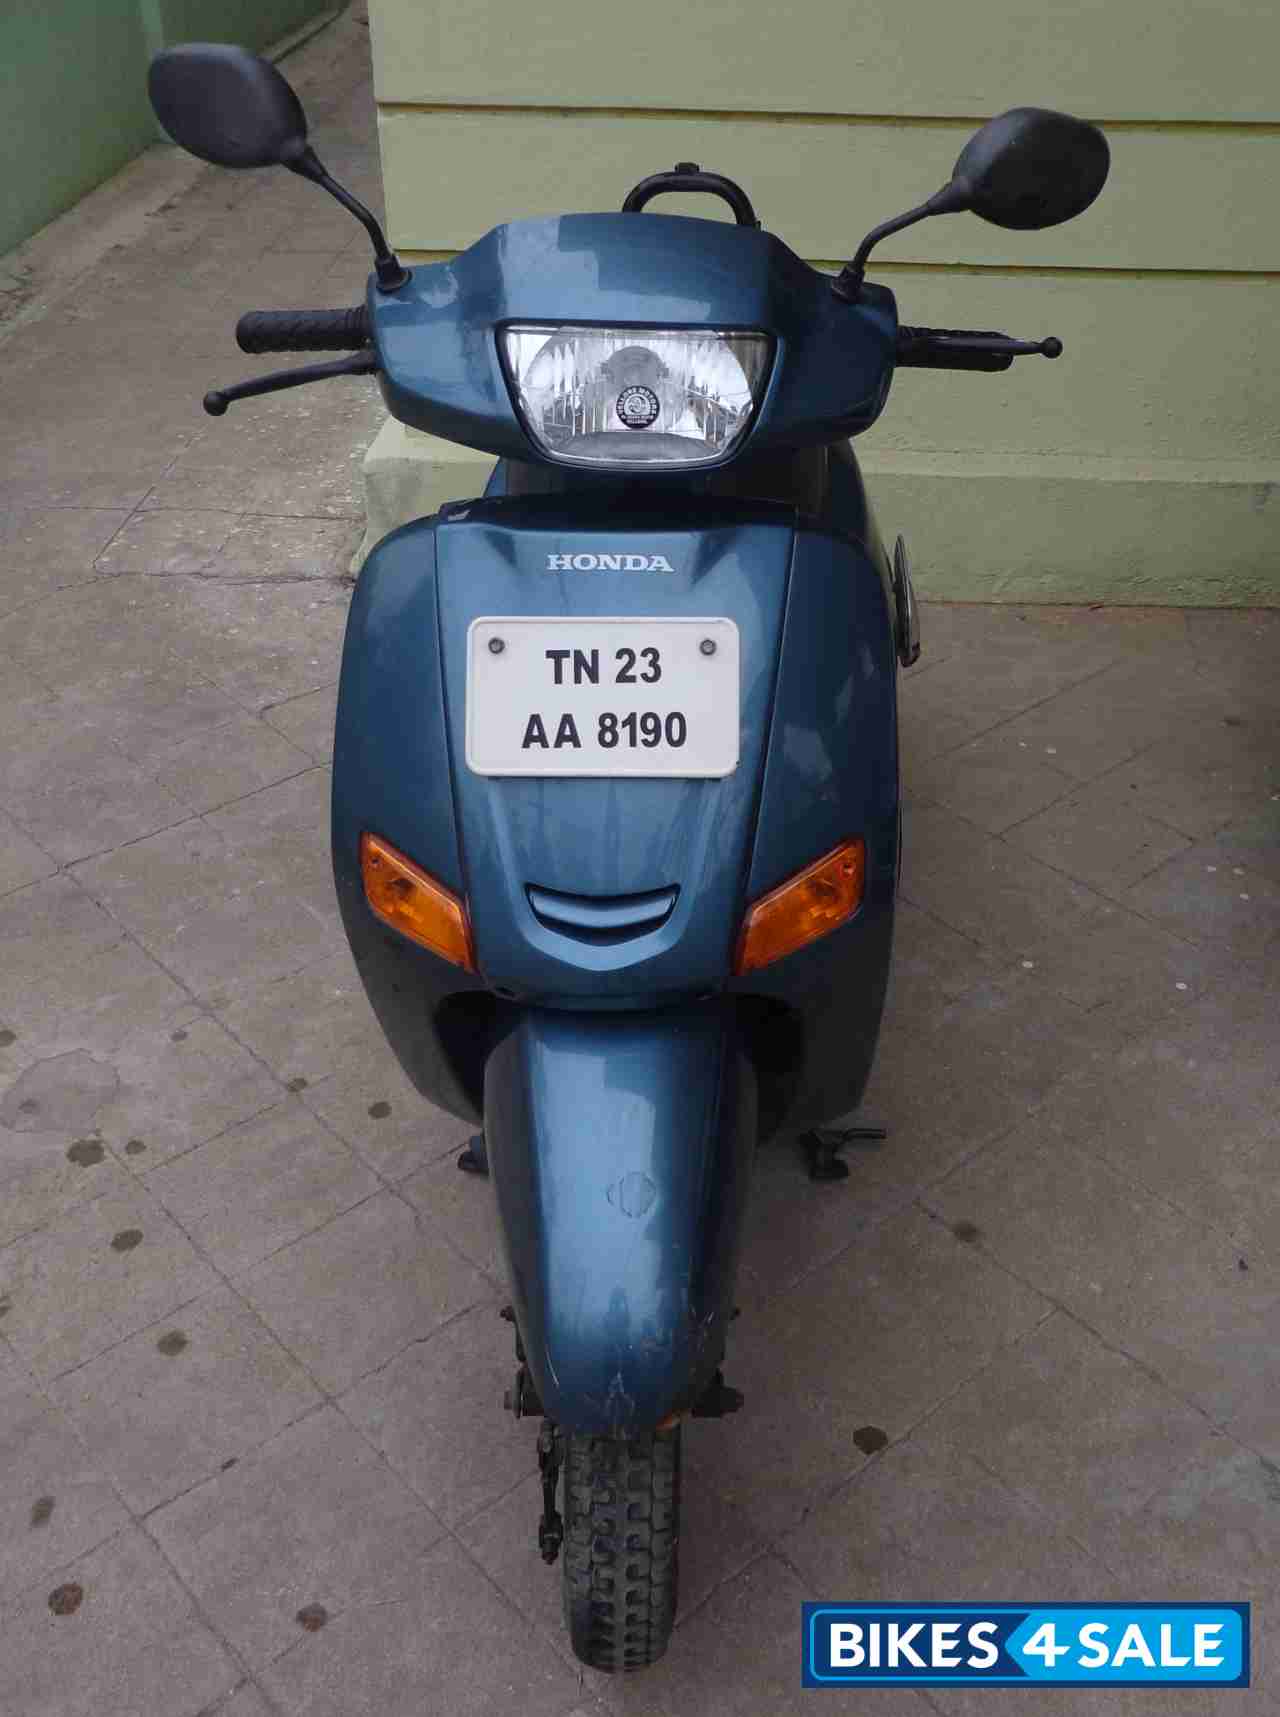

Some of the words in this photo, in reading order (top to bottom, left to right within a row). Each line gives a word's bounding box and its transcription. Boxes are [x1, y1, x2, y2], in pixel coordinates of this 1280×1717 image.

[546, 554, 674, 572] HONDA
[546, 649, 599, 685] TN
[615, 647, 662, 684] 23
[522, 713, 582, 749] AA
[597, 712, 687, 748] 8190
